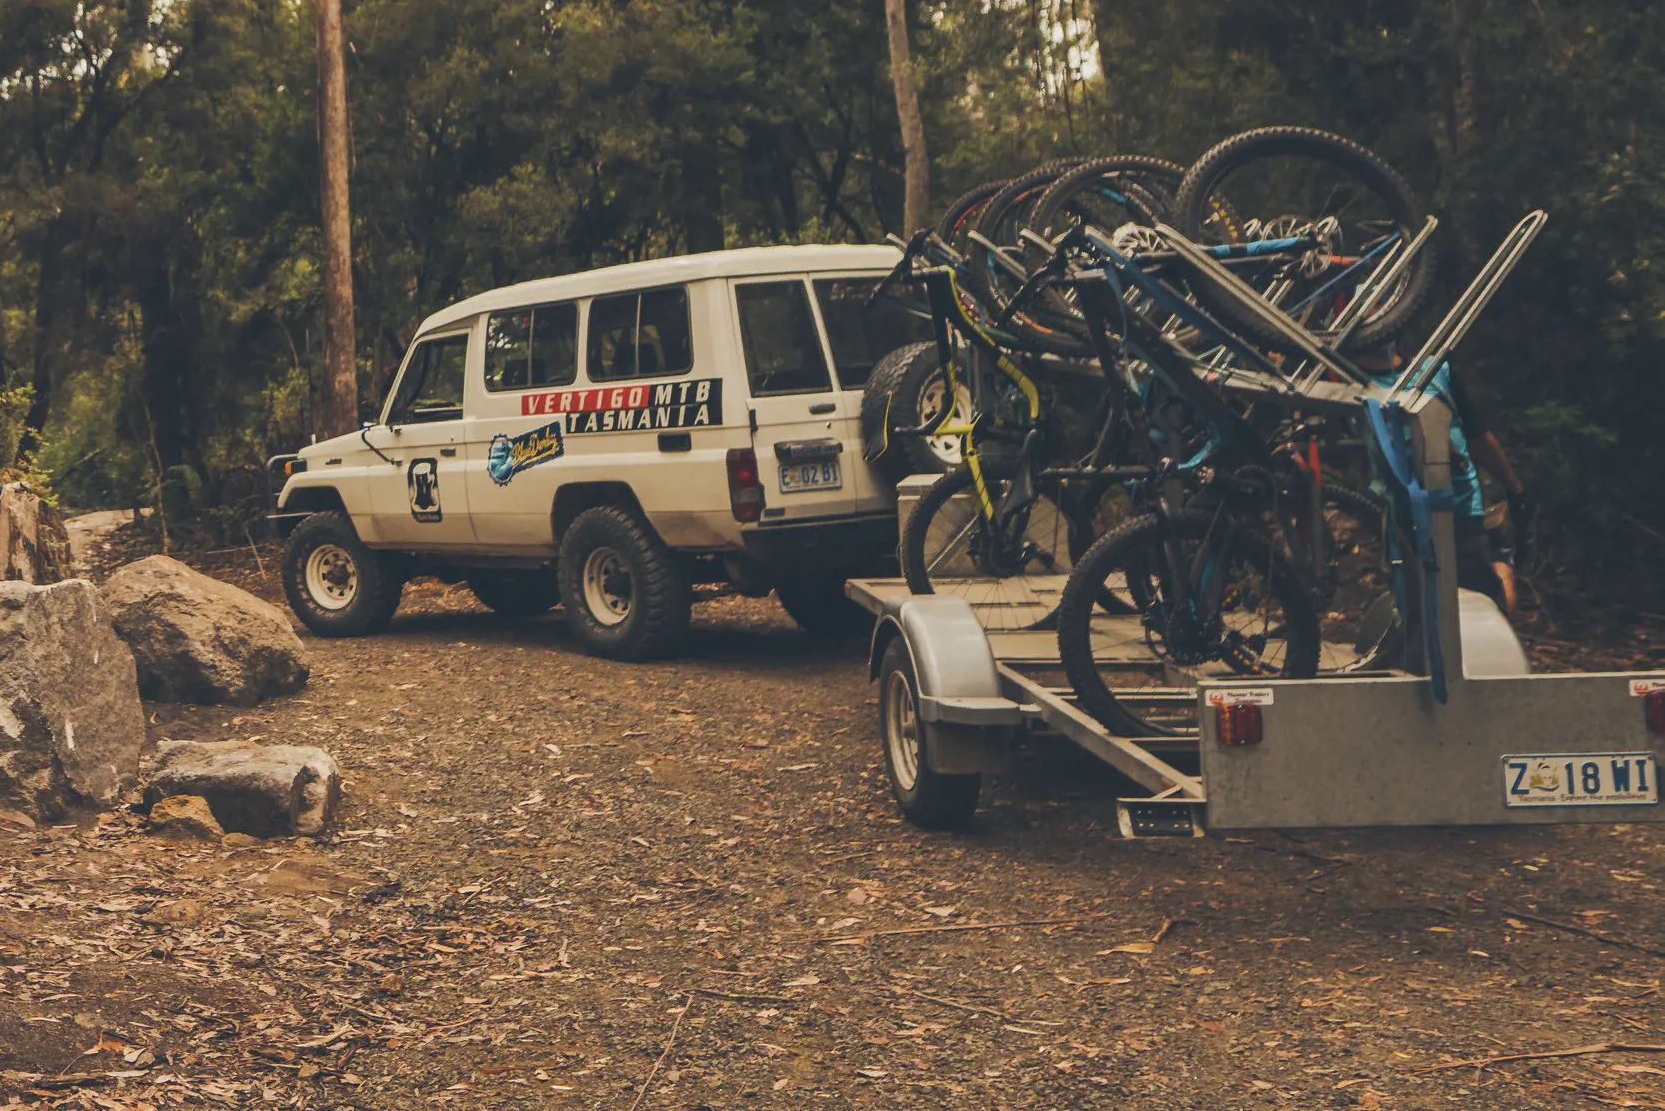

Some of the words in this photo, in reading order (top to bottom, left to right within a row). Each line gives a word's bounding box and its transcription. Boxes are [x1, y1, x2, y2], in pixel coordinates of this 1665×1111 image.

[527, 387, 643, 414] VERTIGO
[654, 380, 711, 406] MTB
[568, 403, 710, 433] TASMANIA
[1508, 762, 1530, 795] Z
[1564, 761, 1601, 794] 18
[1611, 758, 1649, 792] WI
[1518, 794, 1557, 802] Tasmania
